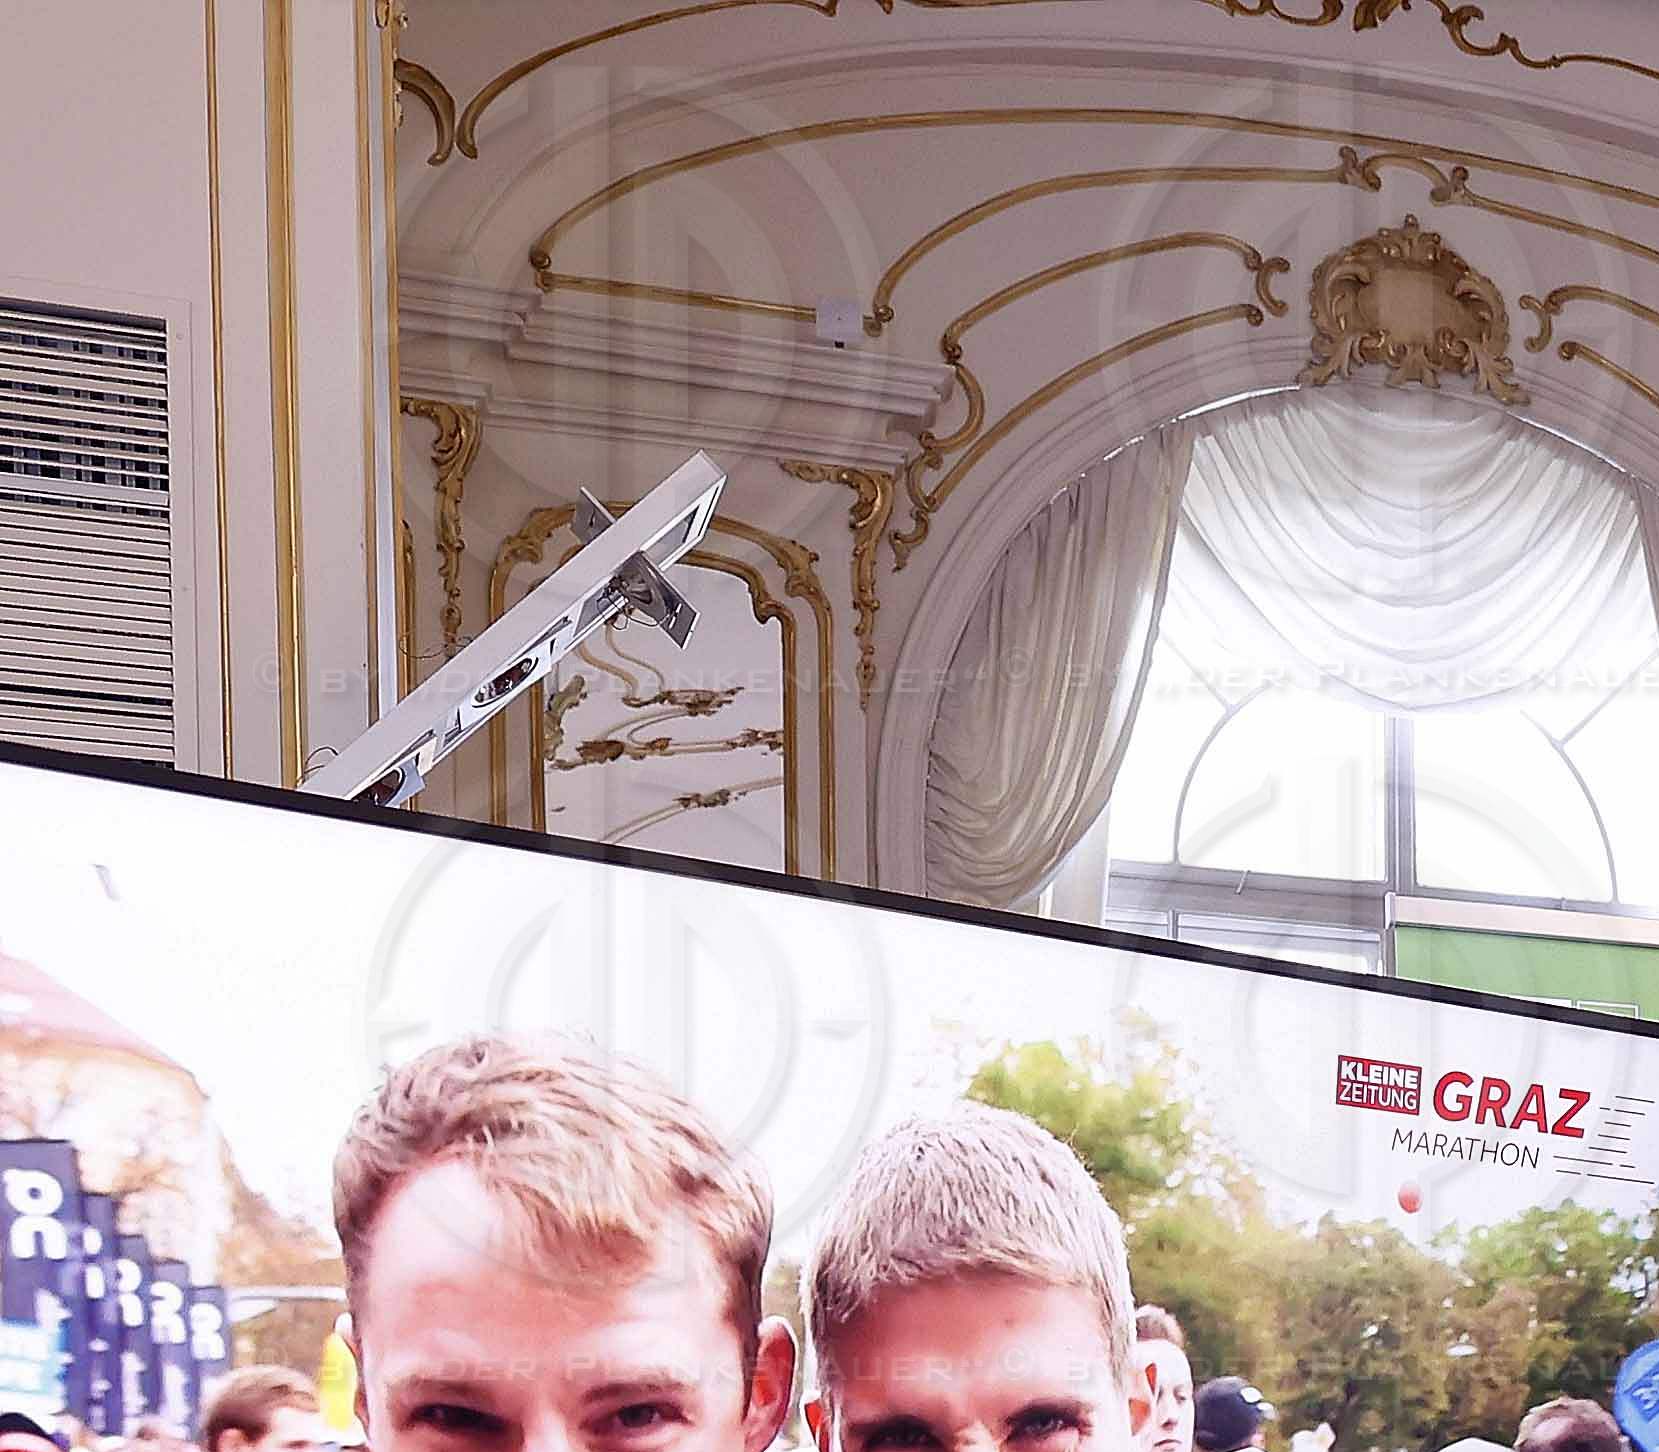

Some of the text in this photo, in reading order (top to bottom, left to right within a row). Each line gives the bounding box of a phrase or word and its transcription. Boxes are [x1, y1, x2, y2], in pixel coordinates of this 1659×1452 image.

[1340, 1060, 1419, 1091] KLEINE
[1338, 1080, 1418, 1111] ZEITUNG
[1433, 1071, 1592, 1138] GRAZ
[1391, 1128, 1540, 1170] MARATHON
